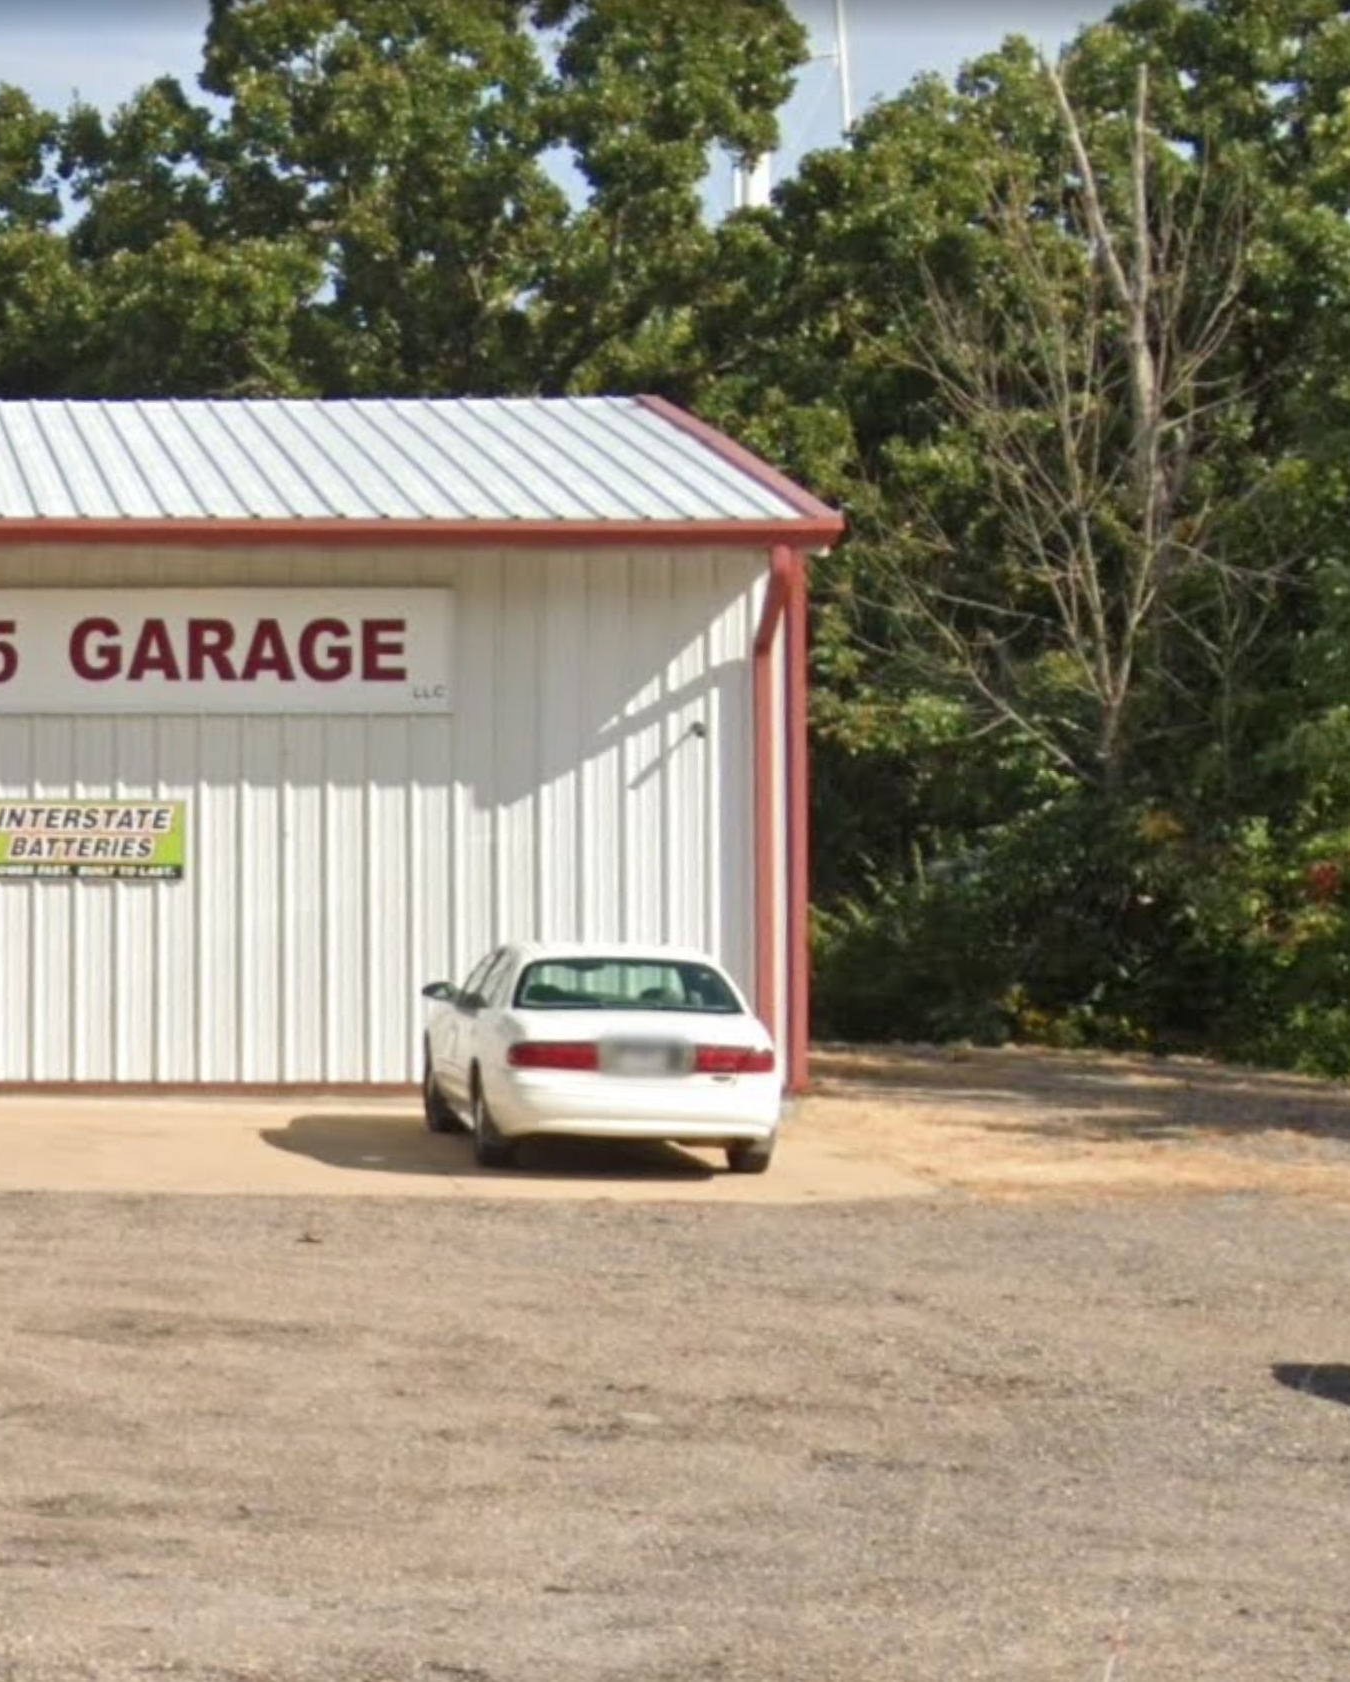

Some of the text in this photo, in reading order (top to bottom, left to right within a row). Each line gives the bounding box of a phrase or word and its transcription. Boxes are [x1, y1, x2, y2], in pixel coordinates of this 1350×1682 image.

[68, 617, 407, 682] GARAGE
[412, 685, 446, 699] LLC
[9, 836, 153, 858] BATTERIES
